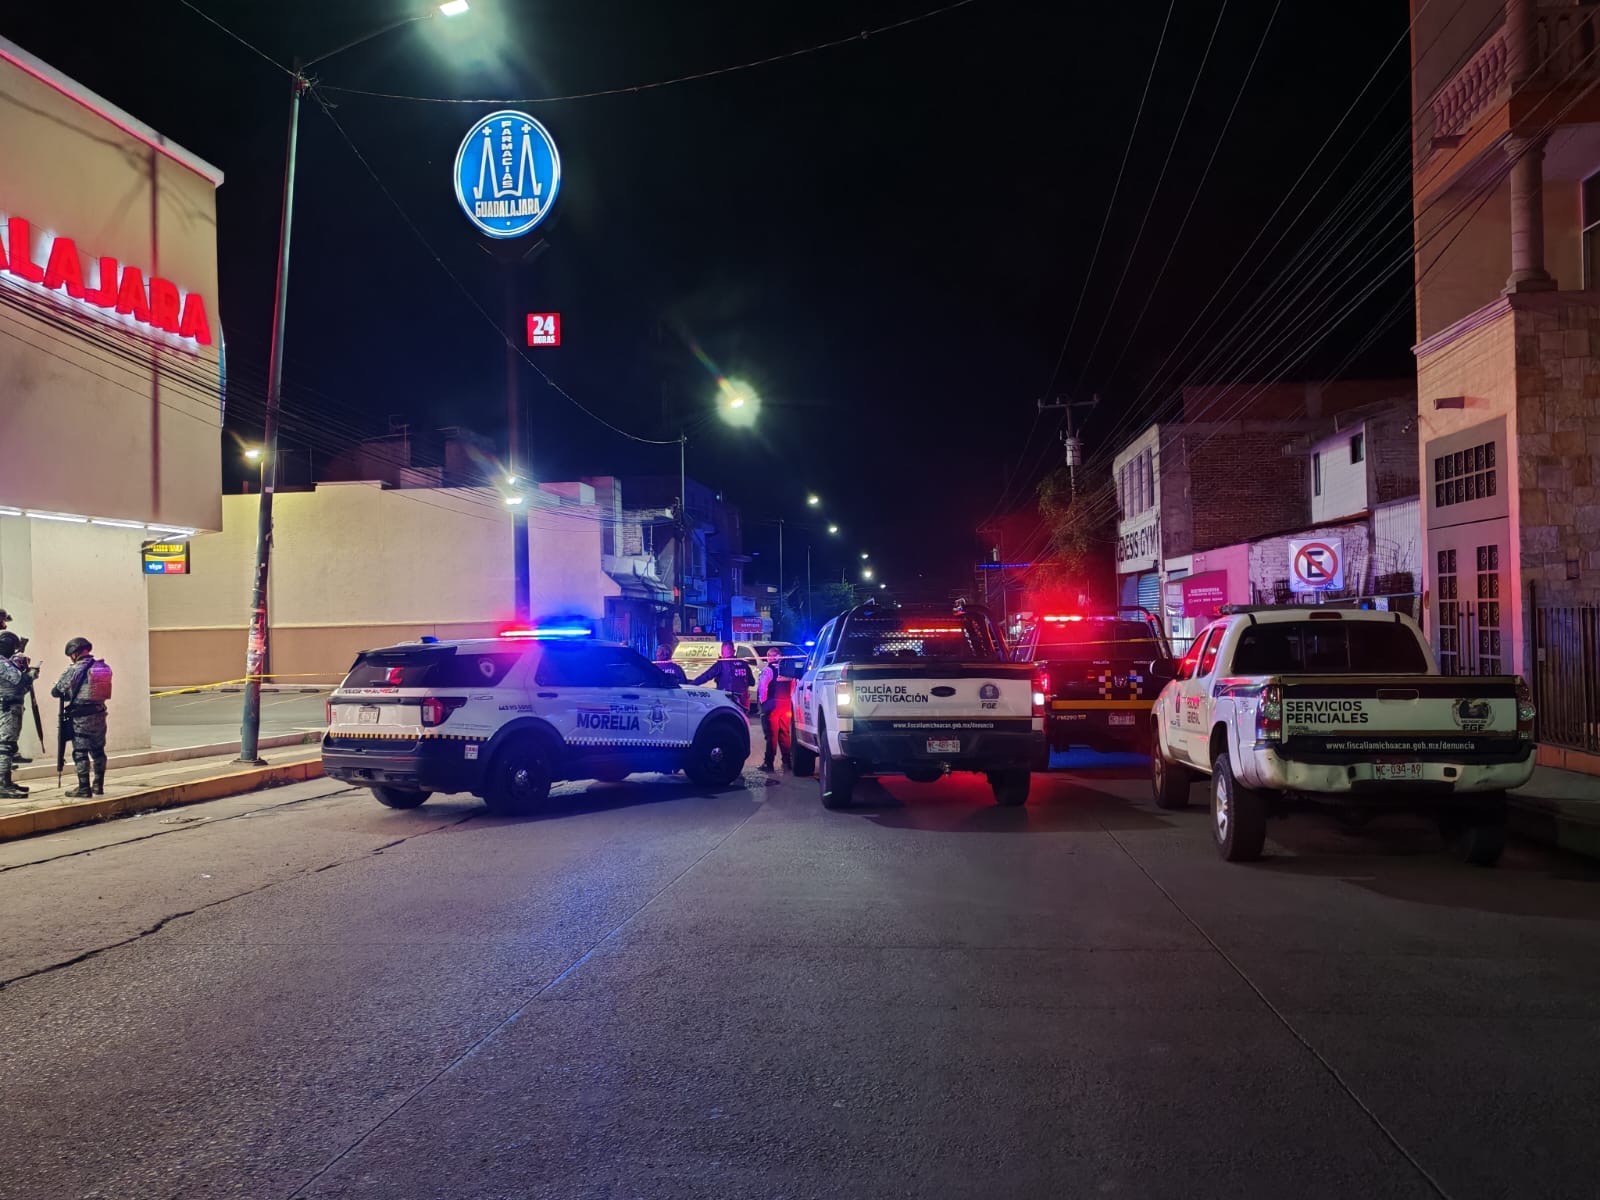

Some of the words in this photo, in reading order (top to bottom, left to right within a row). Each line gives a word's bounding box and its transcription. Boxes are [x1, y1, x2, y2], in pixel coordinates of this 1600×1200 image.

[501, 120, 513, 189] FARMACIAS
[475, 198, 540, 218] GUADALAJARA
[0, 217, 212, 346] LAJARA
[533, 315, 555, 336] 24
[533, 335, 556, 345] HORAS
[1141, 523, 1157, 557] GYM
[894, 685, 907, 695] DE
[1286, 701, 1362, 712] SERVICIOS
[576, 712, 640, 732] MORELIA
[1286, 713, 1369, 724] PERICIALES
